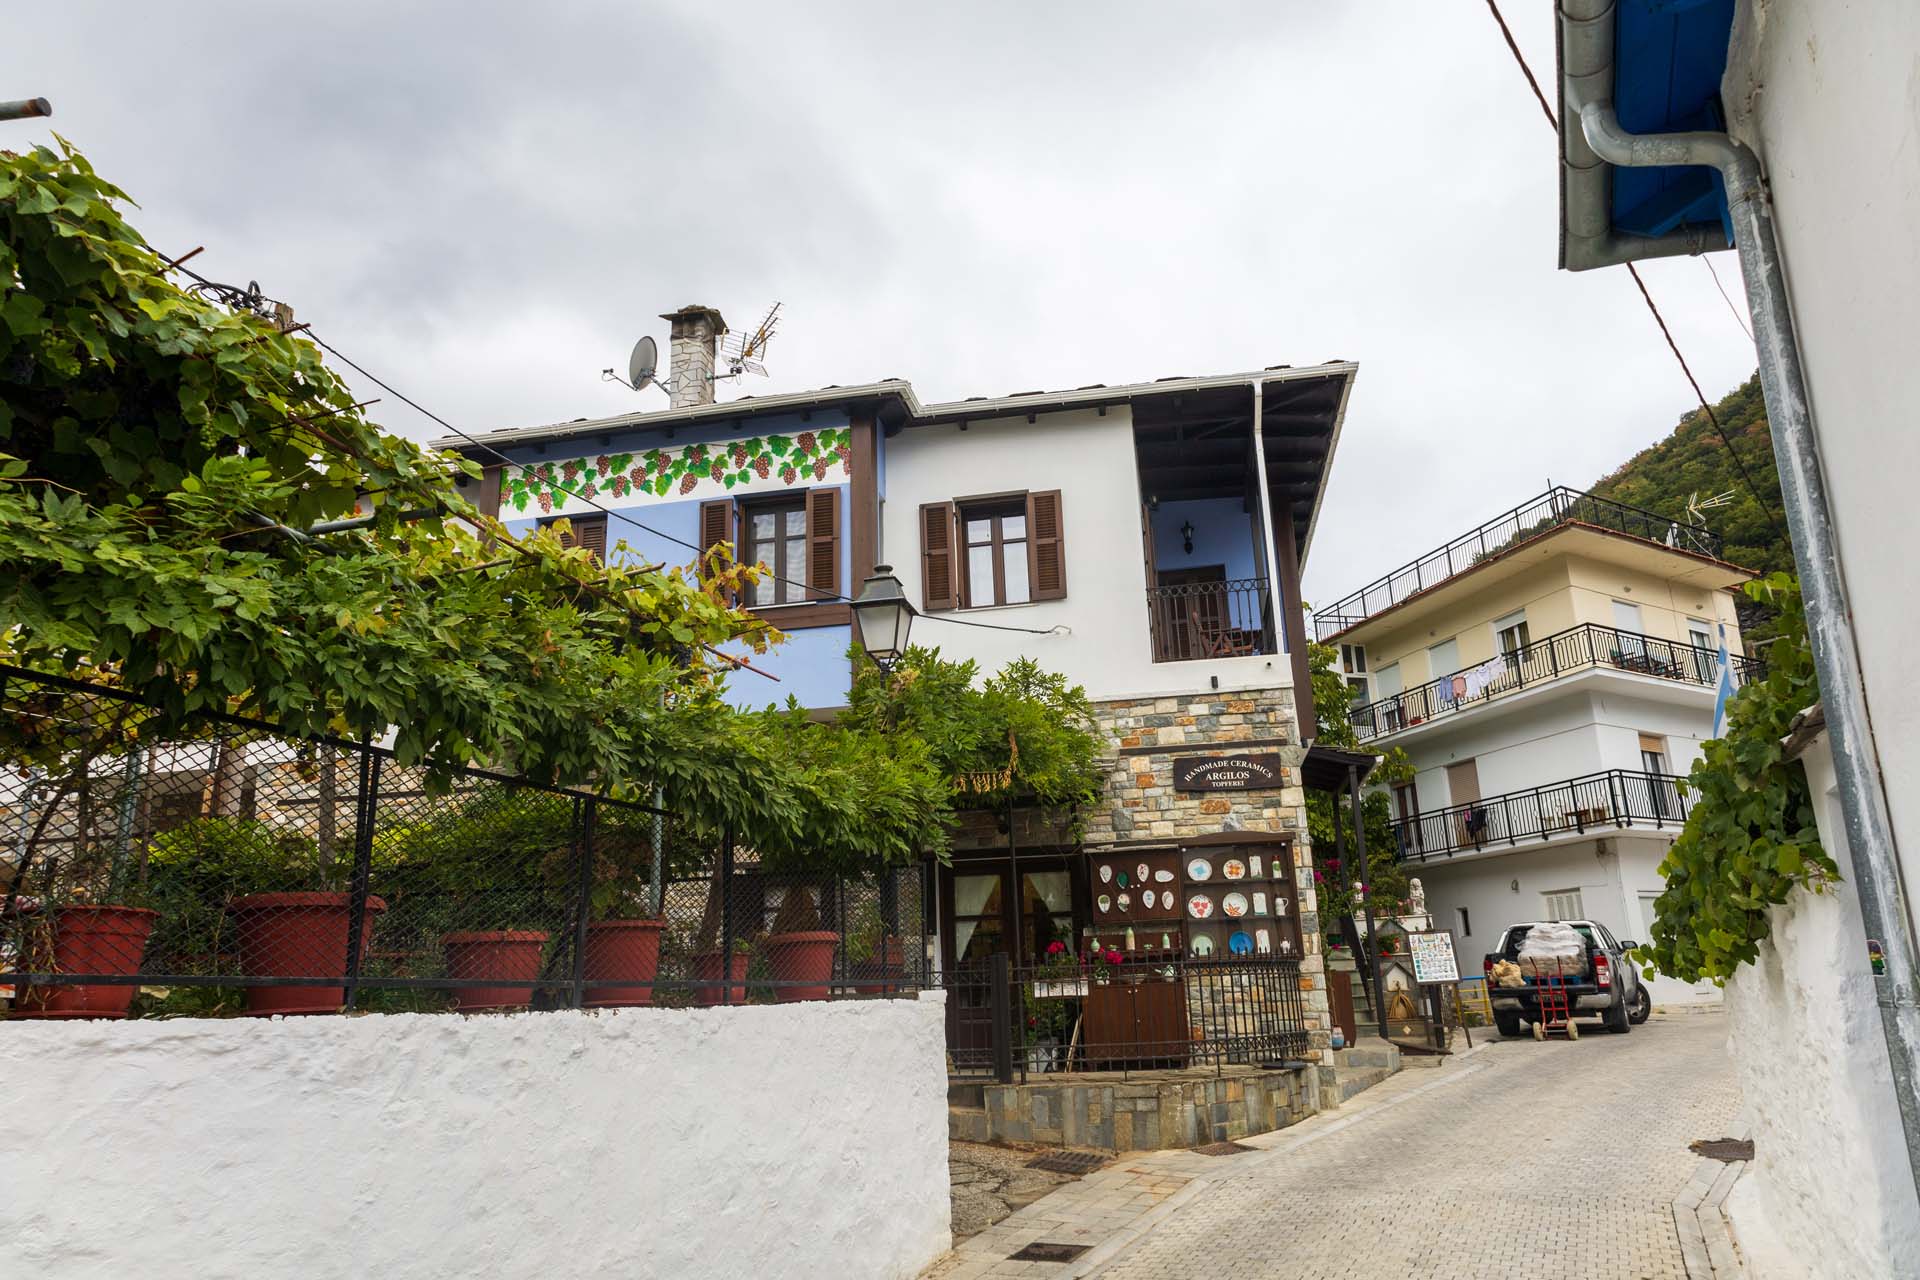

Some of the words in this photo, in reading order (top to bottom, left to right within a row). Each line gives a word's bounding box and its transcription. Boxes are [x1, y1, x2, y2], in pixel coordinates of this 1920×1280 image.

[1184, 760, 1229, 782] HANDMADE
[1230, 760, 1273, 779] CERAMICS
[1206, 771, 1250, 781] ARGILOS
